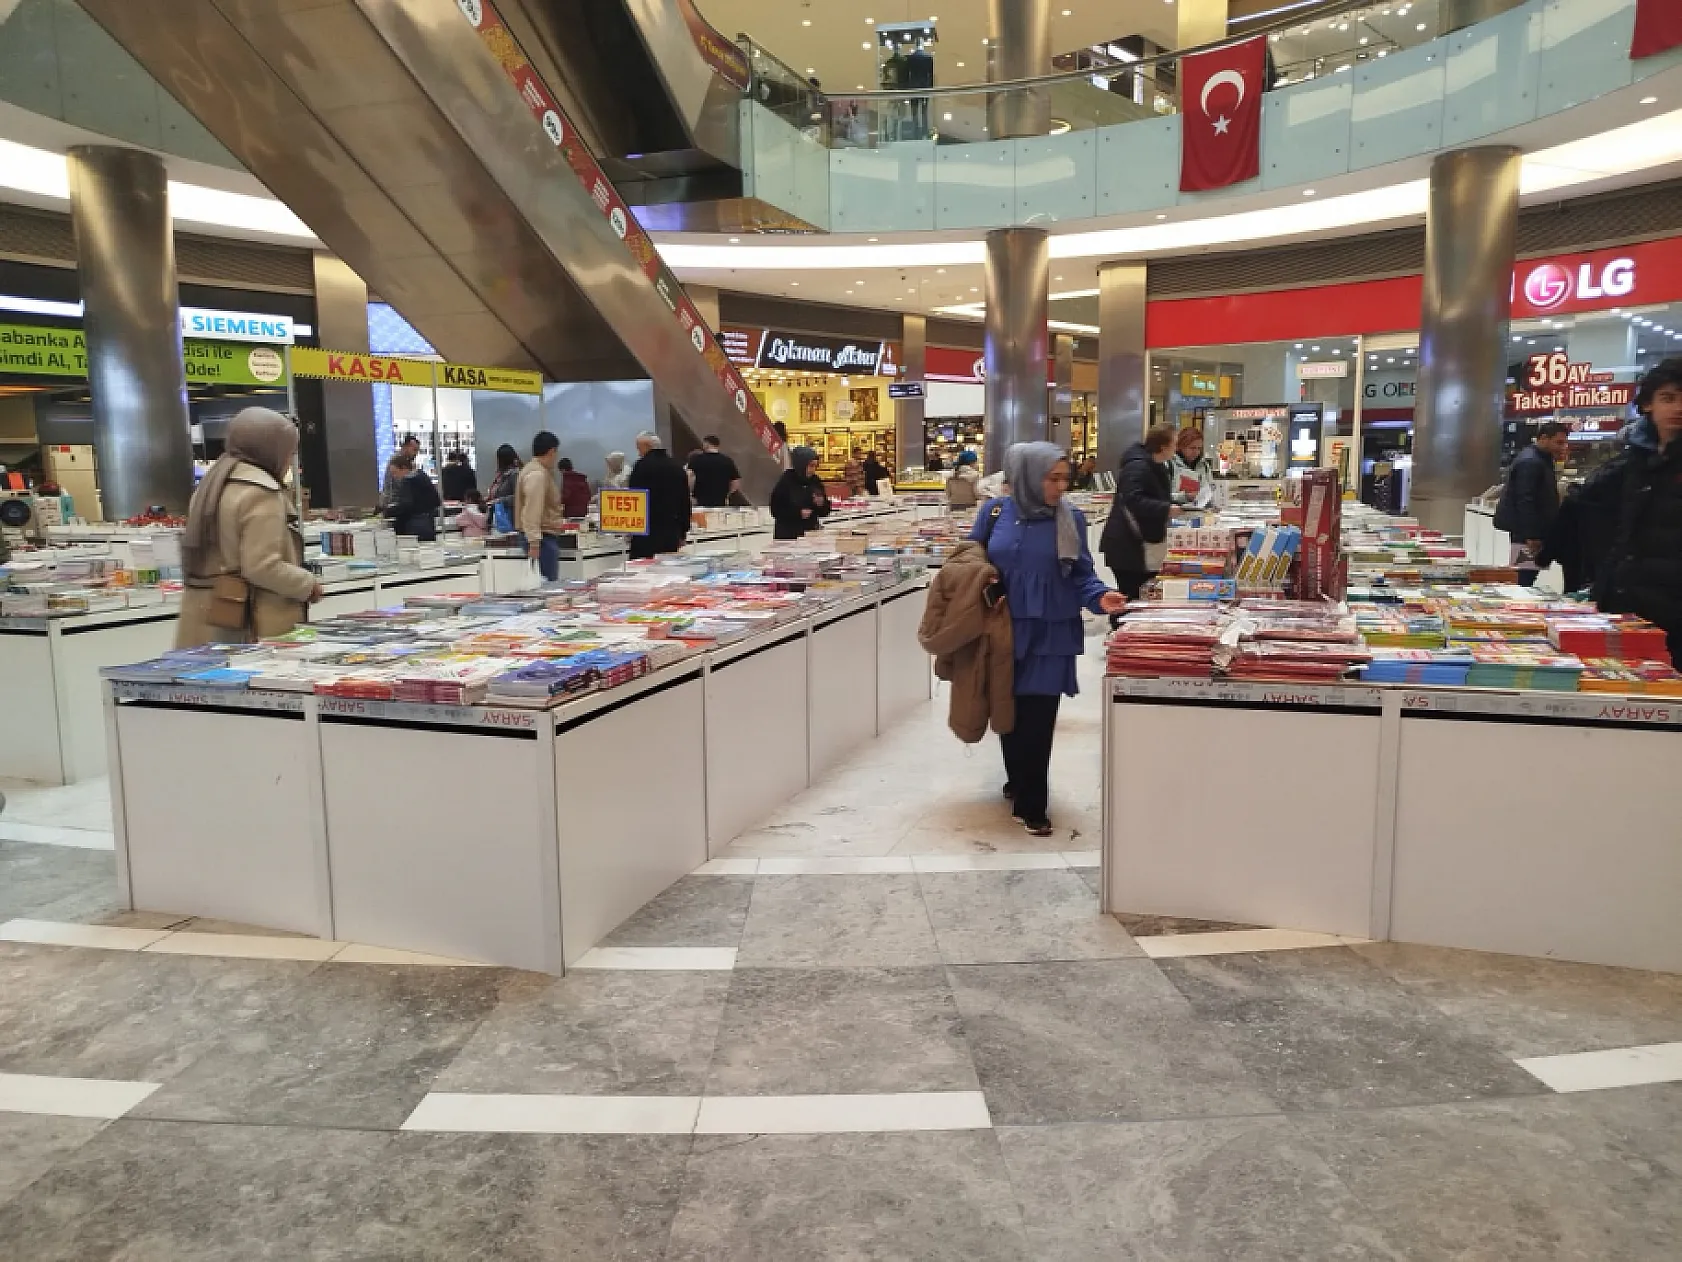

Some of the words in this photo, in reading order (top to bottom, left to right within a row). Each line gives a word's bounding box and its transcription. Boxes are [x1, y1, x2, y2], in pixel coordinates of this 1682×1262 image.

[1577, 258, 1635, 299] LG
[192, 315, 288, 338] SIEMENS
[0, 349, 43, 367] imdi
[327, 354, 404, 382] KASA
[444, 366, 488, 387] KASA
[1511, 388, 1565, 412] Taksit
[606, 496, 640, 513] TEST
[321, 698, 366, 713] SARAY
[1598, 705, 1670, 721] SARAY
[481, 710, 532, 728] SARAY
